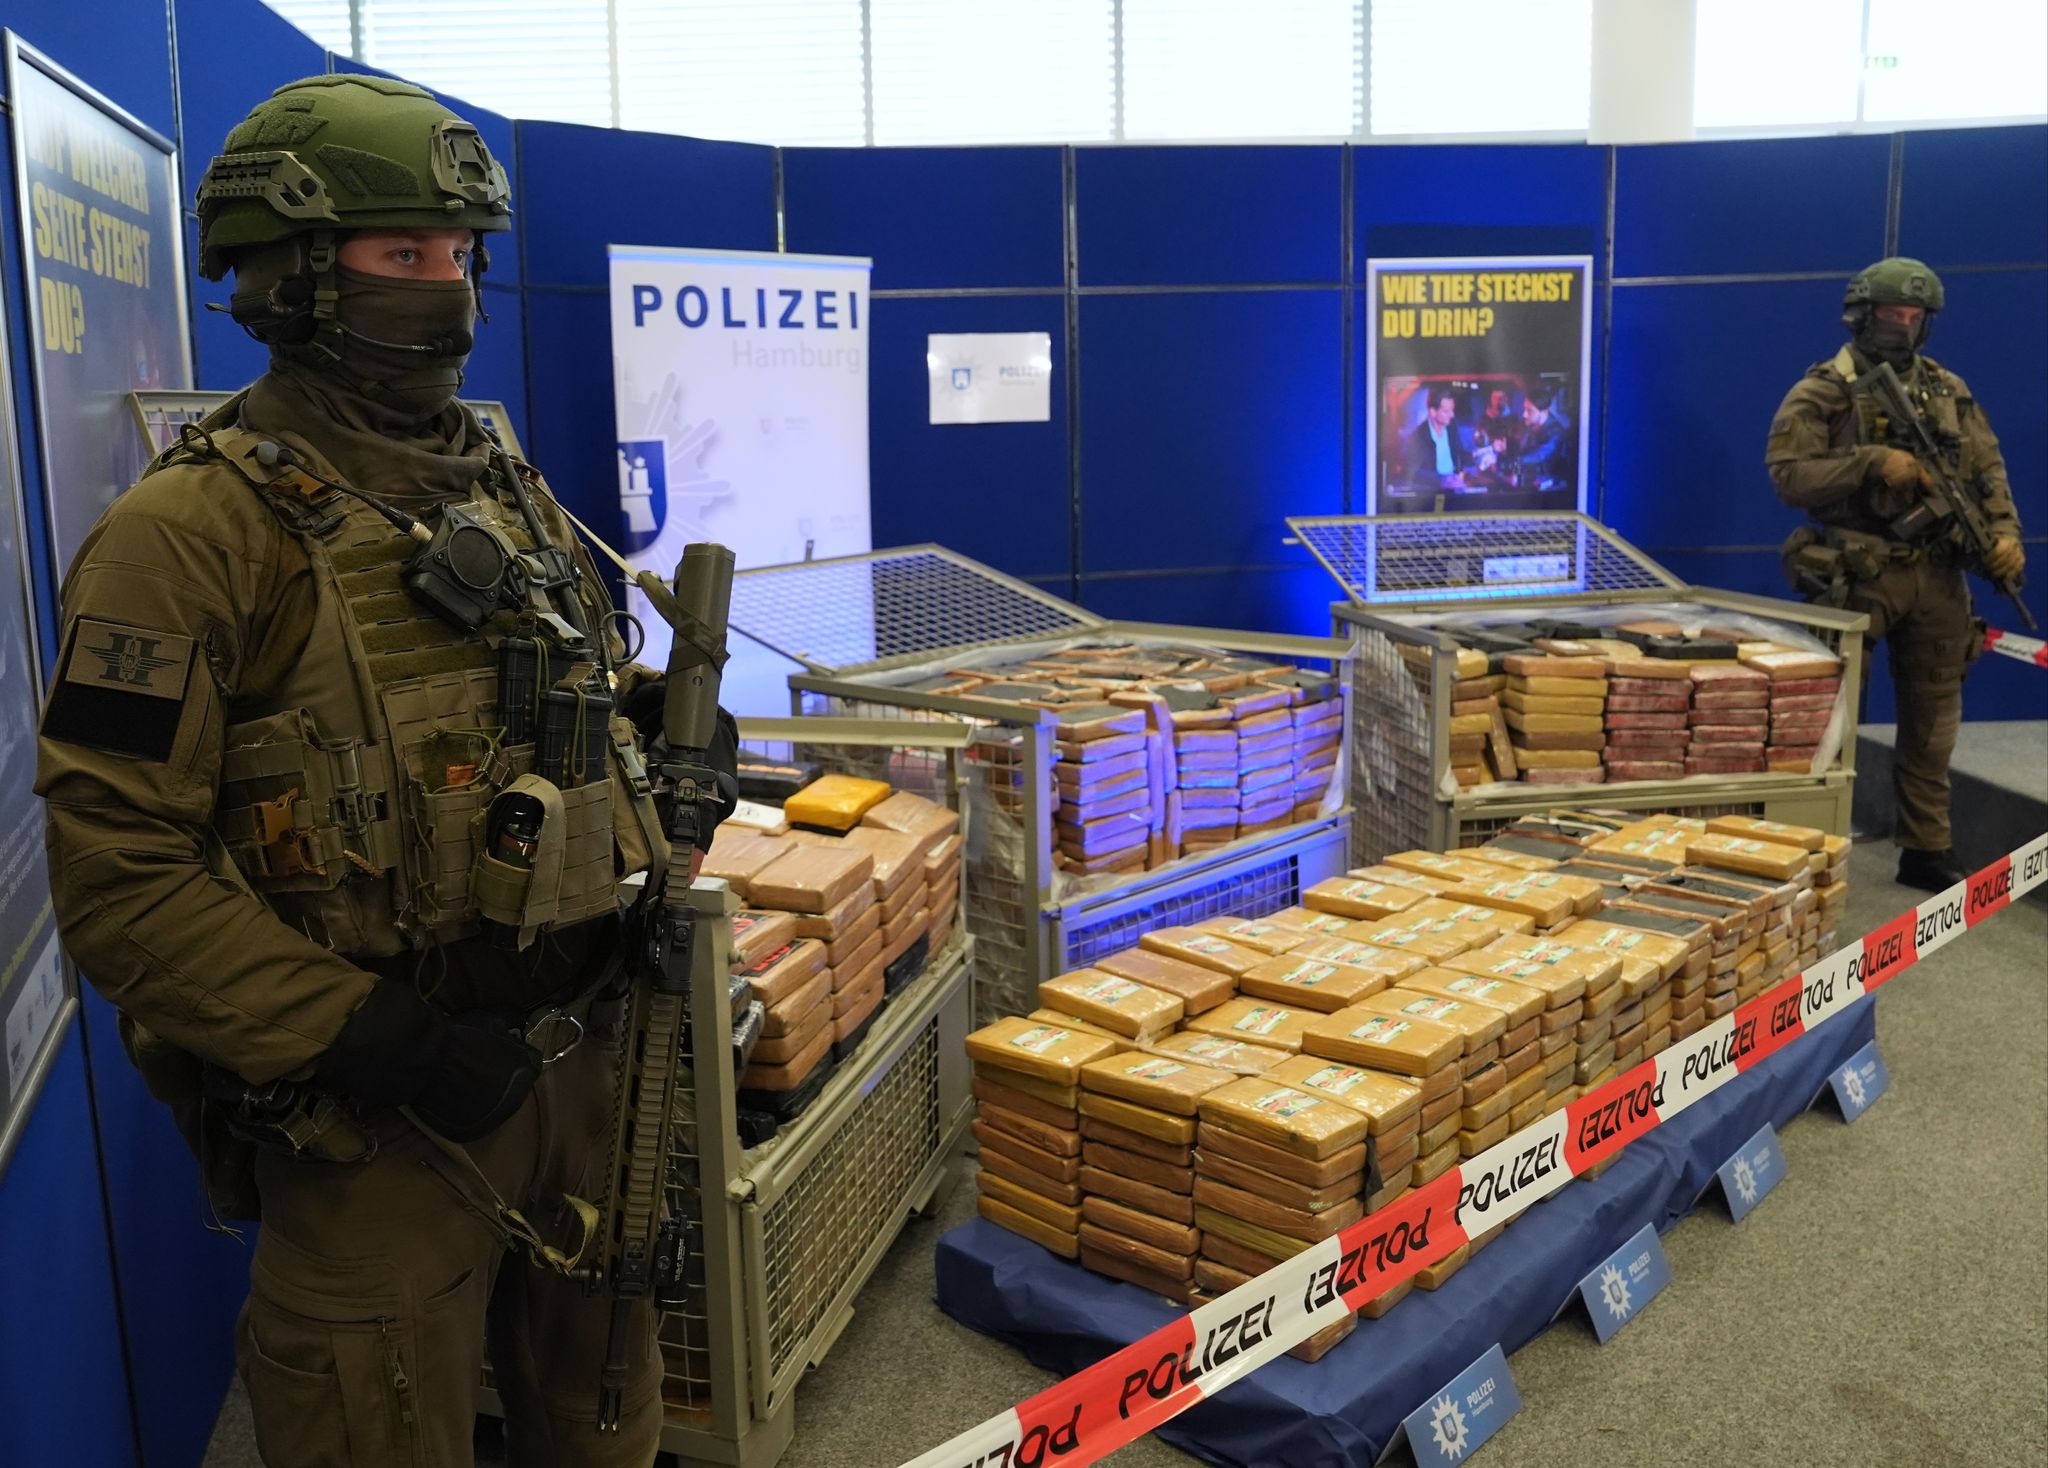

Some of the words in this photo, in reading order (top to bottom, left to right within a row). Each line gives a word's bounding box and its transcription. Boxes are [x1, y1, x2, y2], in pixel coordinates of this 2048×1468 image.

[69, 112, 149, 215] WELCHER
[32, 181, 88, 270] SEITE
[88, 206, 150, 289] STEHST
[40, 276, 85, 354] DU?
[632, 284, 858, 329] POLIZEI
[1382, 274, 1427, 304] WIE
[1429, 273, 1475, 303] TIEF
[1477, 272, 1573, 303] STECKST
[1382, 308, 1416, 338] DU
[1420, 307, 1494, 337] DRIN?
[732, 339, 861, 375] Hamburg
[1971, 864, 2016, 914] POLIZEI
[1913, 895, 1963, 949] POLIZEI
[1846, 931, 1903, 990] POLIZEI
[1770, 972, 1835, 1037] POLIZEI
[1682, 1017, 1757, 1090] POLIZEI
[1578, 1070, 1667, 1153] POLIZEI
[1454, 1133, 1560, 1226] POLIZEI
[1304, 1207, 1431, 1314] POLIZEI
[1118, 1295, 1276, 1420] POLIZEI
[1466, 1377, 1496, 1408] POLIZEI
